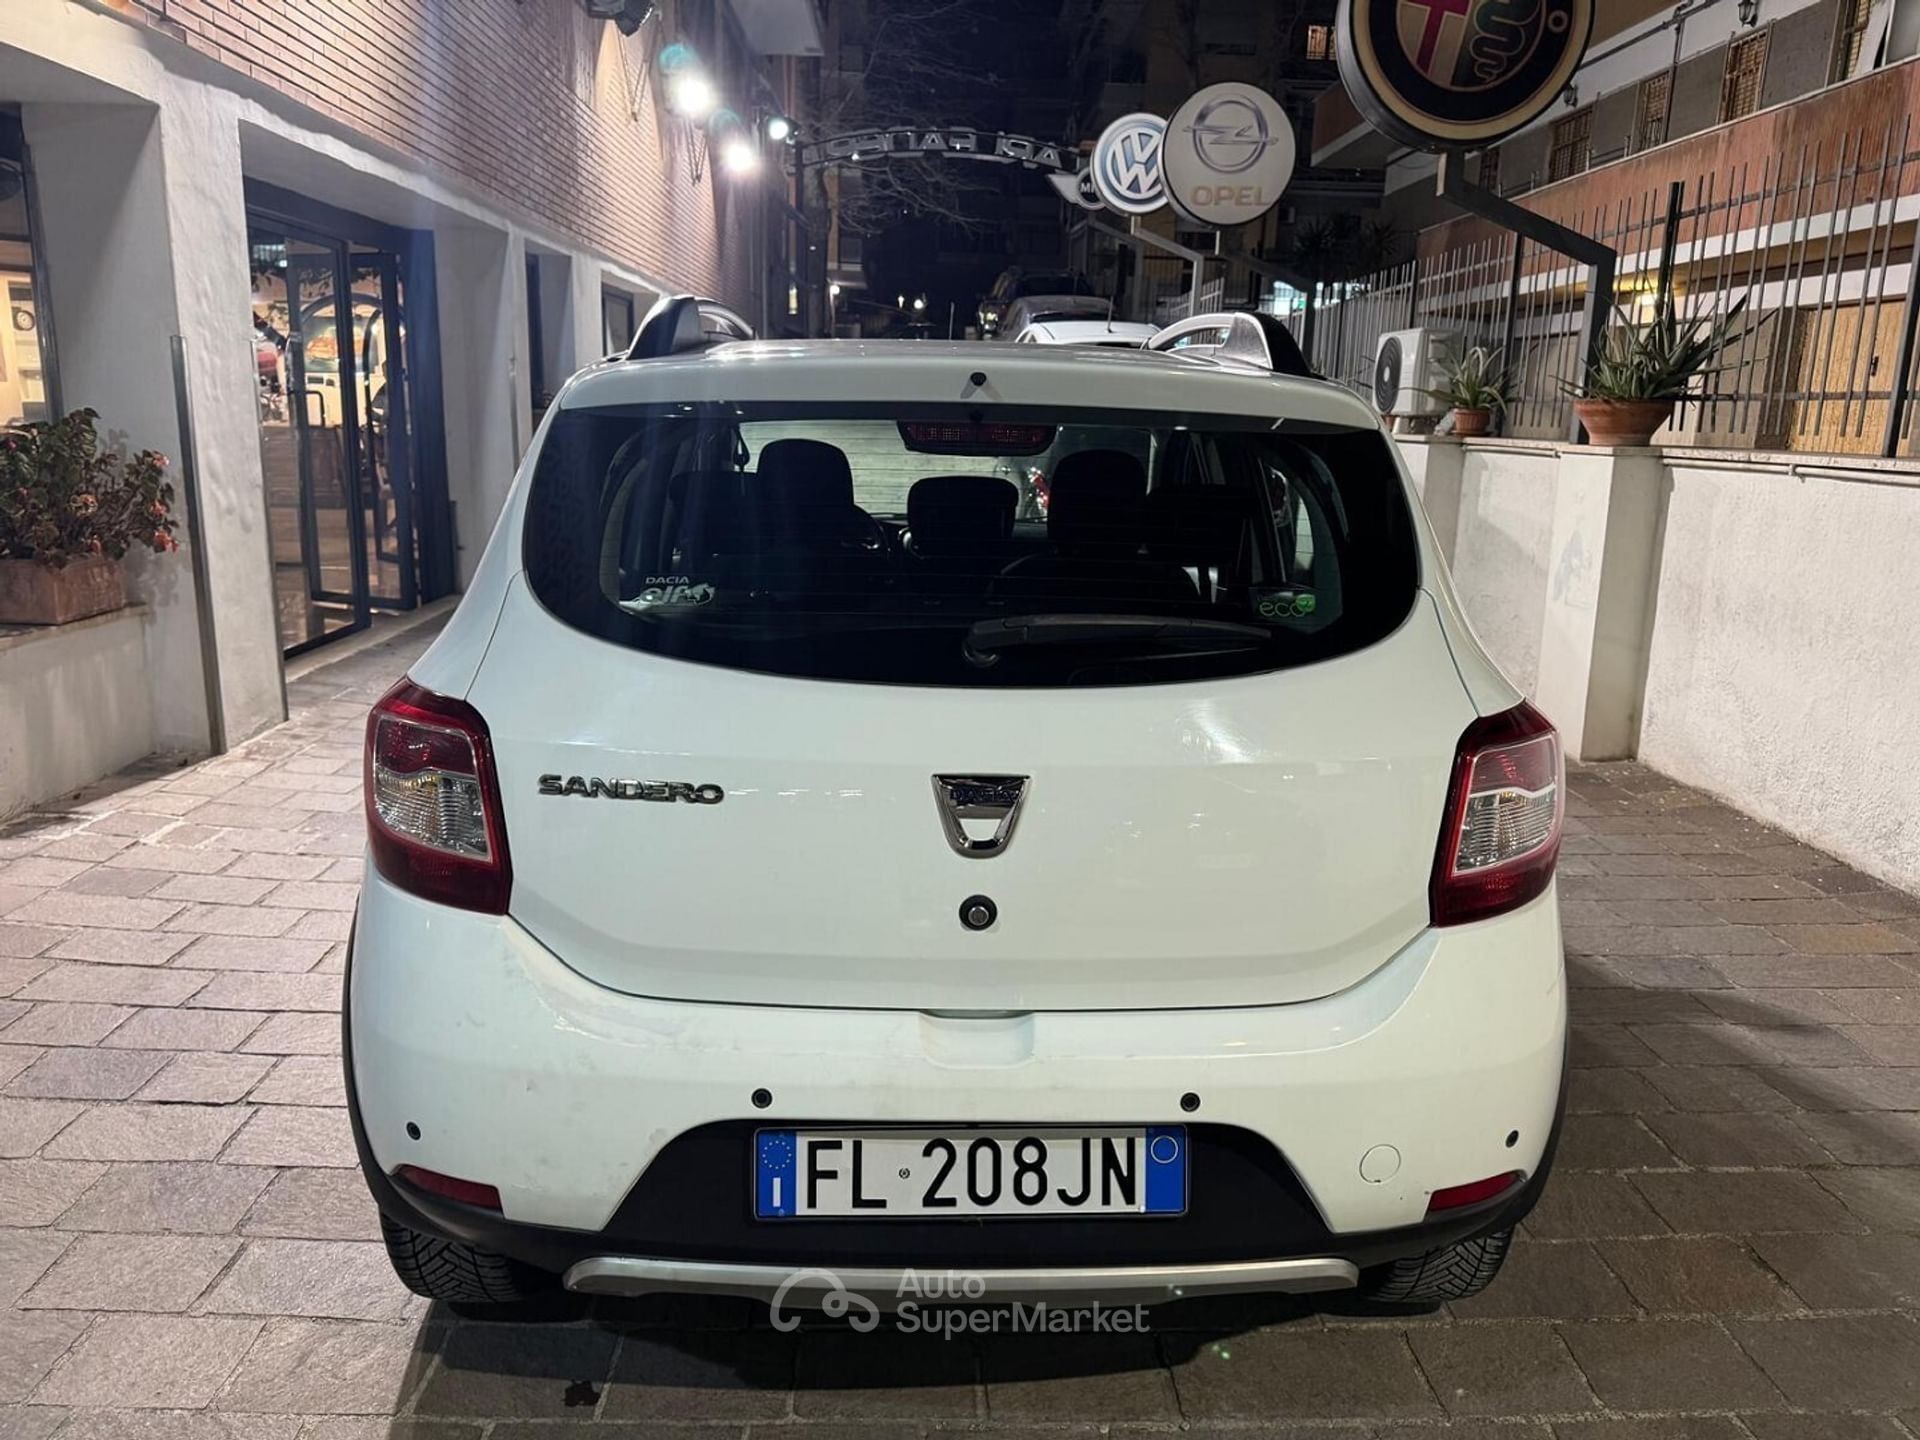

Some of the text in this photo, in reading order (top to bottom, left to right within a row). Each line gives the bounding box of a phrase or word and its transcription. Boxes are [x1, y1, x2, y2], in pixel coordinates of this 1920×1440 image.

[1190, 185, 1272, 206] OPEL
[645, 576, 690, 585] DACIA
[537, 773, 725, 804] SANDERO
[807, 1140, 888, 1209] FL
[922, 1136, 1137, 1208] 208JN
